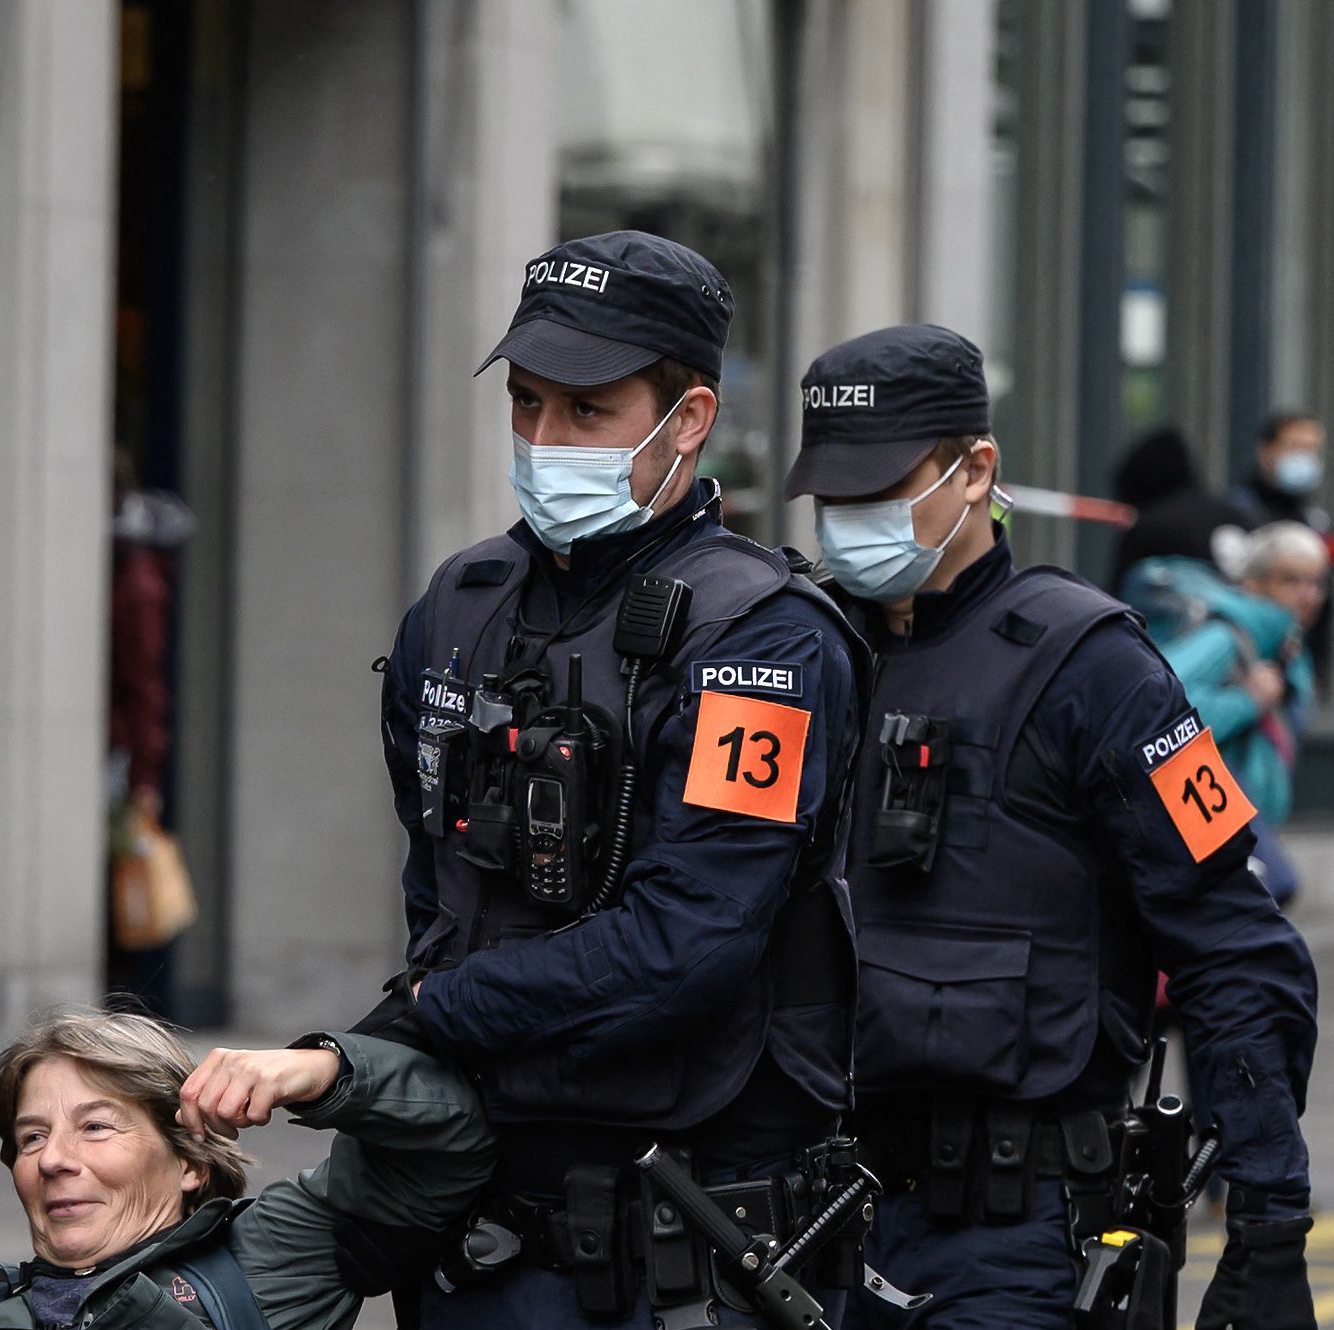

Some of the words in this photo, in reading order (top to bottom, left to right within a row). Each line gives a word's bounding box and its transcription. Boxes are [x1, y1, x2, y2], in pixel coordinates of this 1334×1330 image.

[526, 261, 610, 294] POLIZEI
[422, 680, 467, 713] Polize
[701, 666, 793, 690] POLIZEI
[718, 726, 781, 789] 13
[1142, 716, 1200, 765] POLIZEI
[1182, 765, 1227, 824] 13
